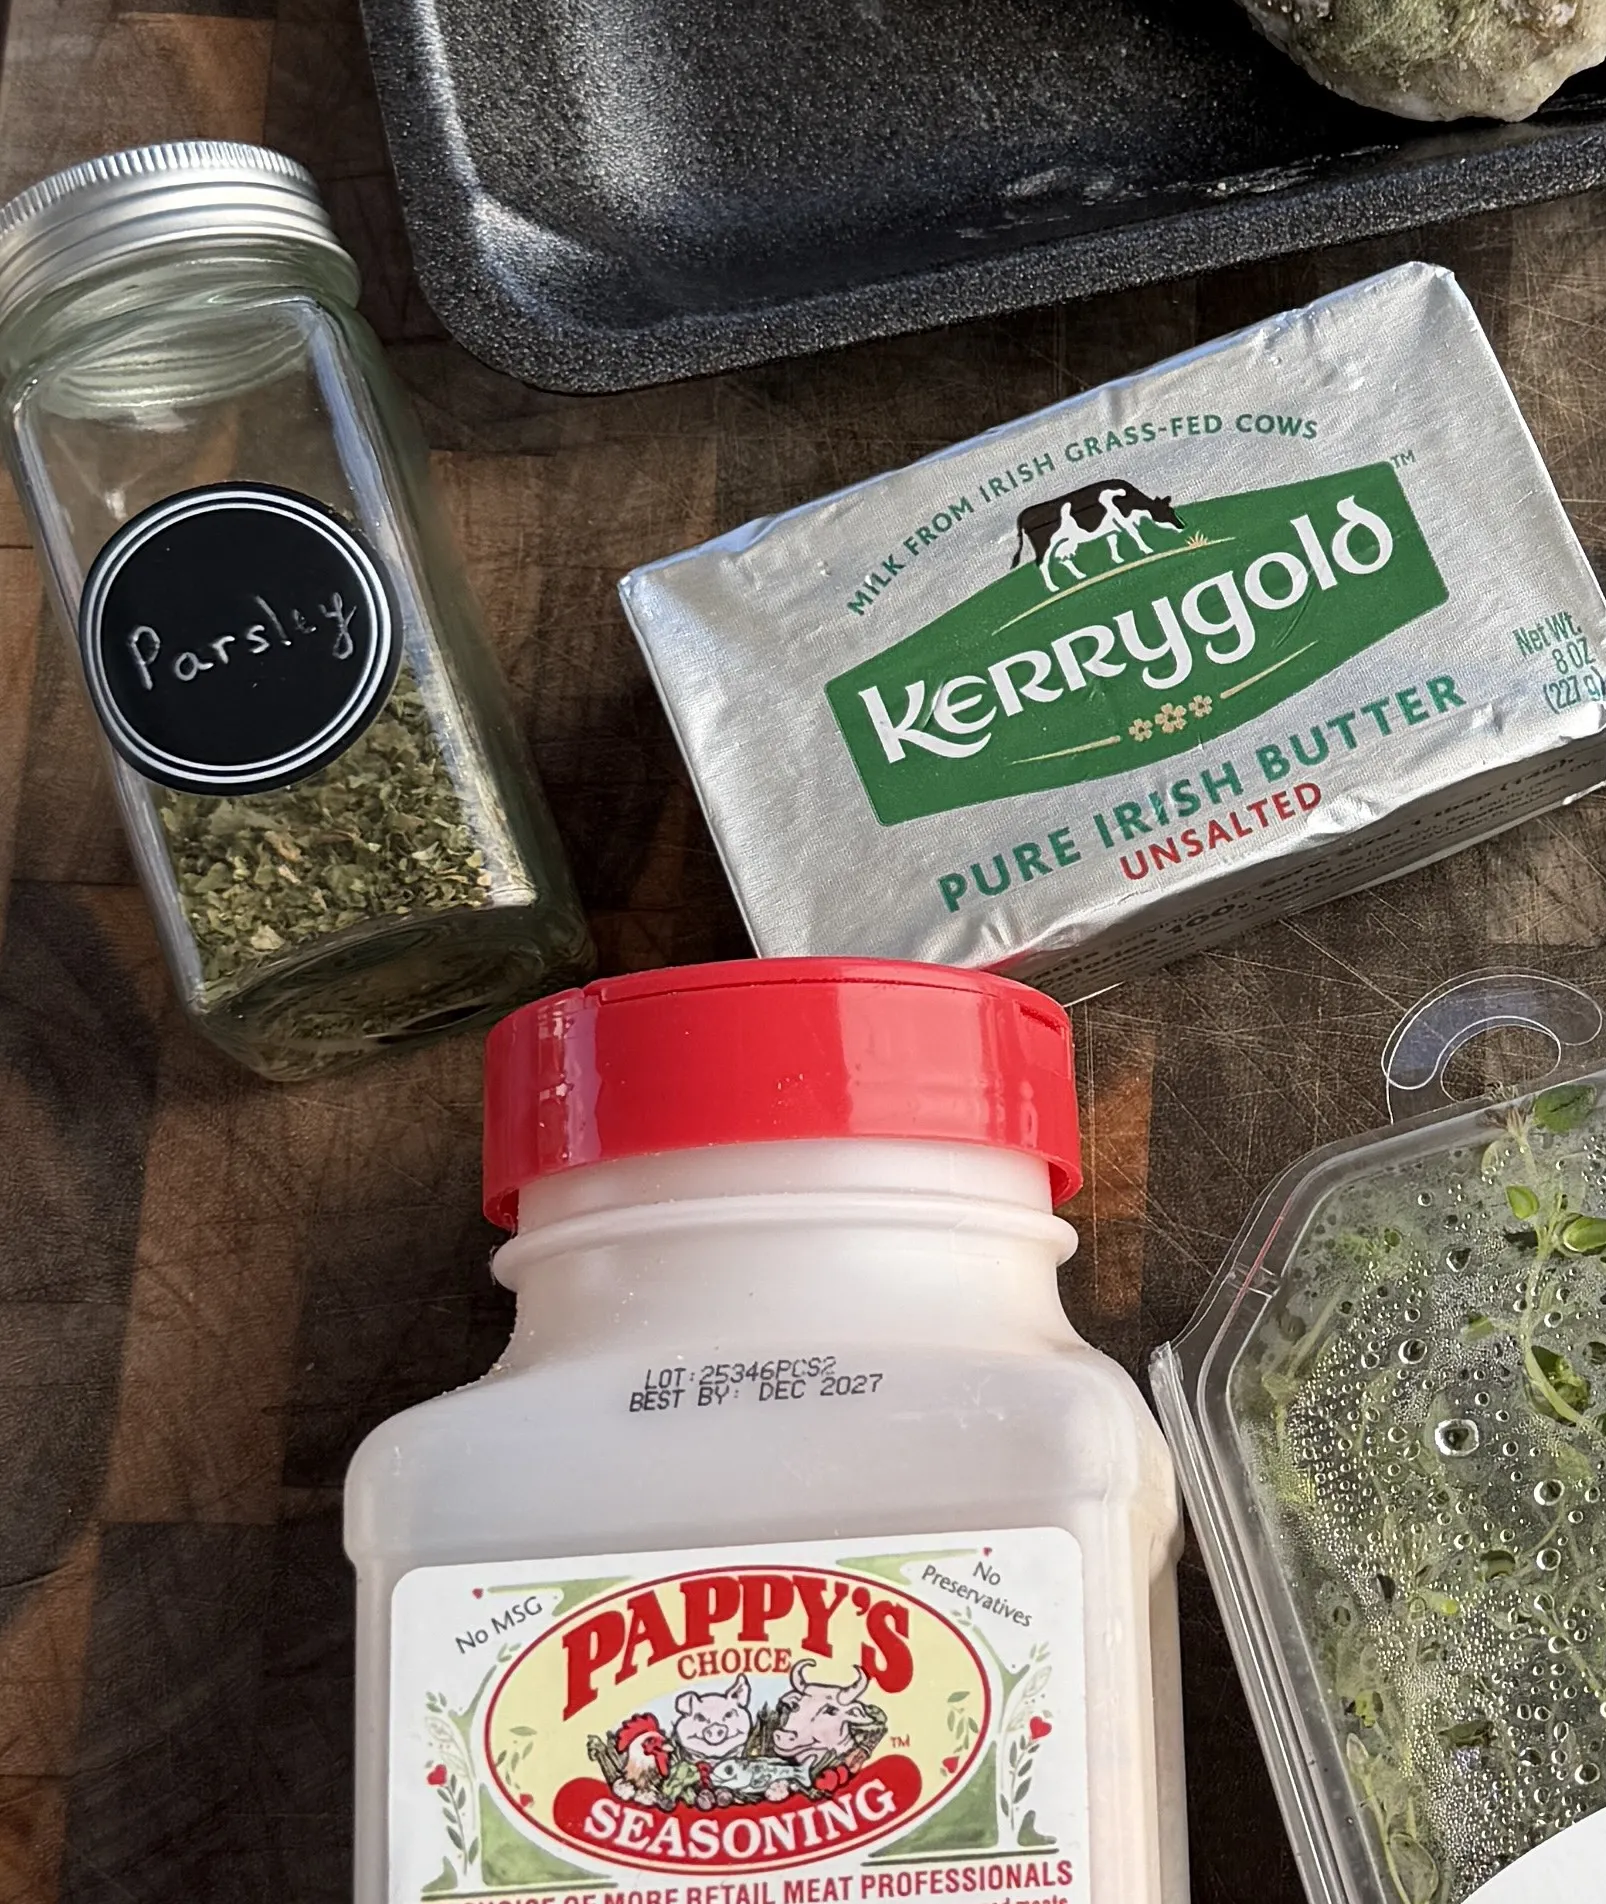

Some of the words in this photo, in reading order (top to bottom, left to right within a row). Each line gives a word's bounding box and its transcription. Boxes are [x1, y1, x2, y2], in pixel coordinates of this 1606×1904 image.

[845, 557, 906, 617] MILK
[905, 500, 975, 558] FROM
[978, 452, 1057, 505] IRISH
[1064, 413, 1224, 465] GRASS-FED
[1235, 412, 1319, 441] COWS
[127, 592, 358, 691] Parsley
[1512, 624, 1550, 657] Net
[1549, 610, 1582, 641] Wt.
[1552, 648, 1569, 674] 8
[1572, 637, 1596, 668] OZ
[1542, 675, 1583, 715] (227
[936, 826, 1083, 913] PURE
[1092, 759, 1244, 849] IRISH
[1256, 674, 1467, 784] BUTTER
[1118, 780, 1323, 881] UNSALTED
[629, 1389, 686, 1412] BEST
[697, 1384, 739, 1407] BY:
[759, 1379, 807, 1402] DEC
[820, 1373, 883, 1397] 2027
[921, 1561, 1035, 1631] Preservatives
[971, 1557, 1003, 1587] No
[454, 1626, 492, 1656] No
[491, 1595, 545, 1634] MSG
[562, 1573, 913, 1723] PAPPY'S
[676, 1645, 793, 1679] CHOICE
[582, 1778, 897, 1859] SEASONING
[782, 1875, 854, 1904] MEAT
[860, 1859, 1074, 1900] PROFESSIONALS
